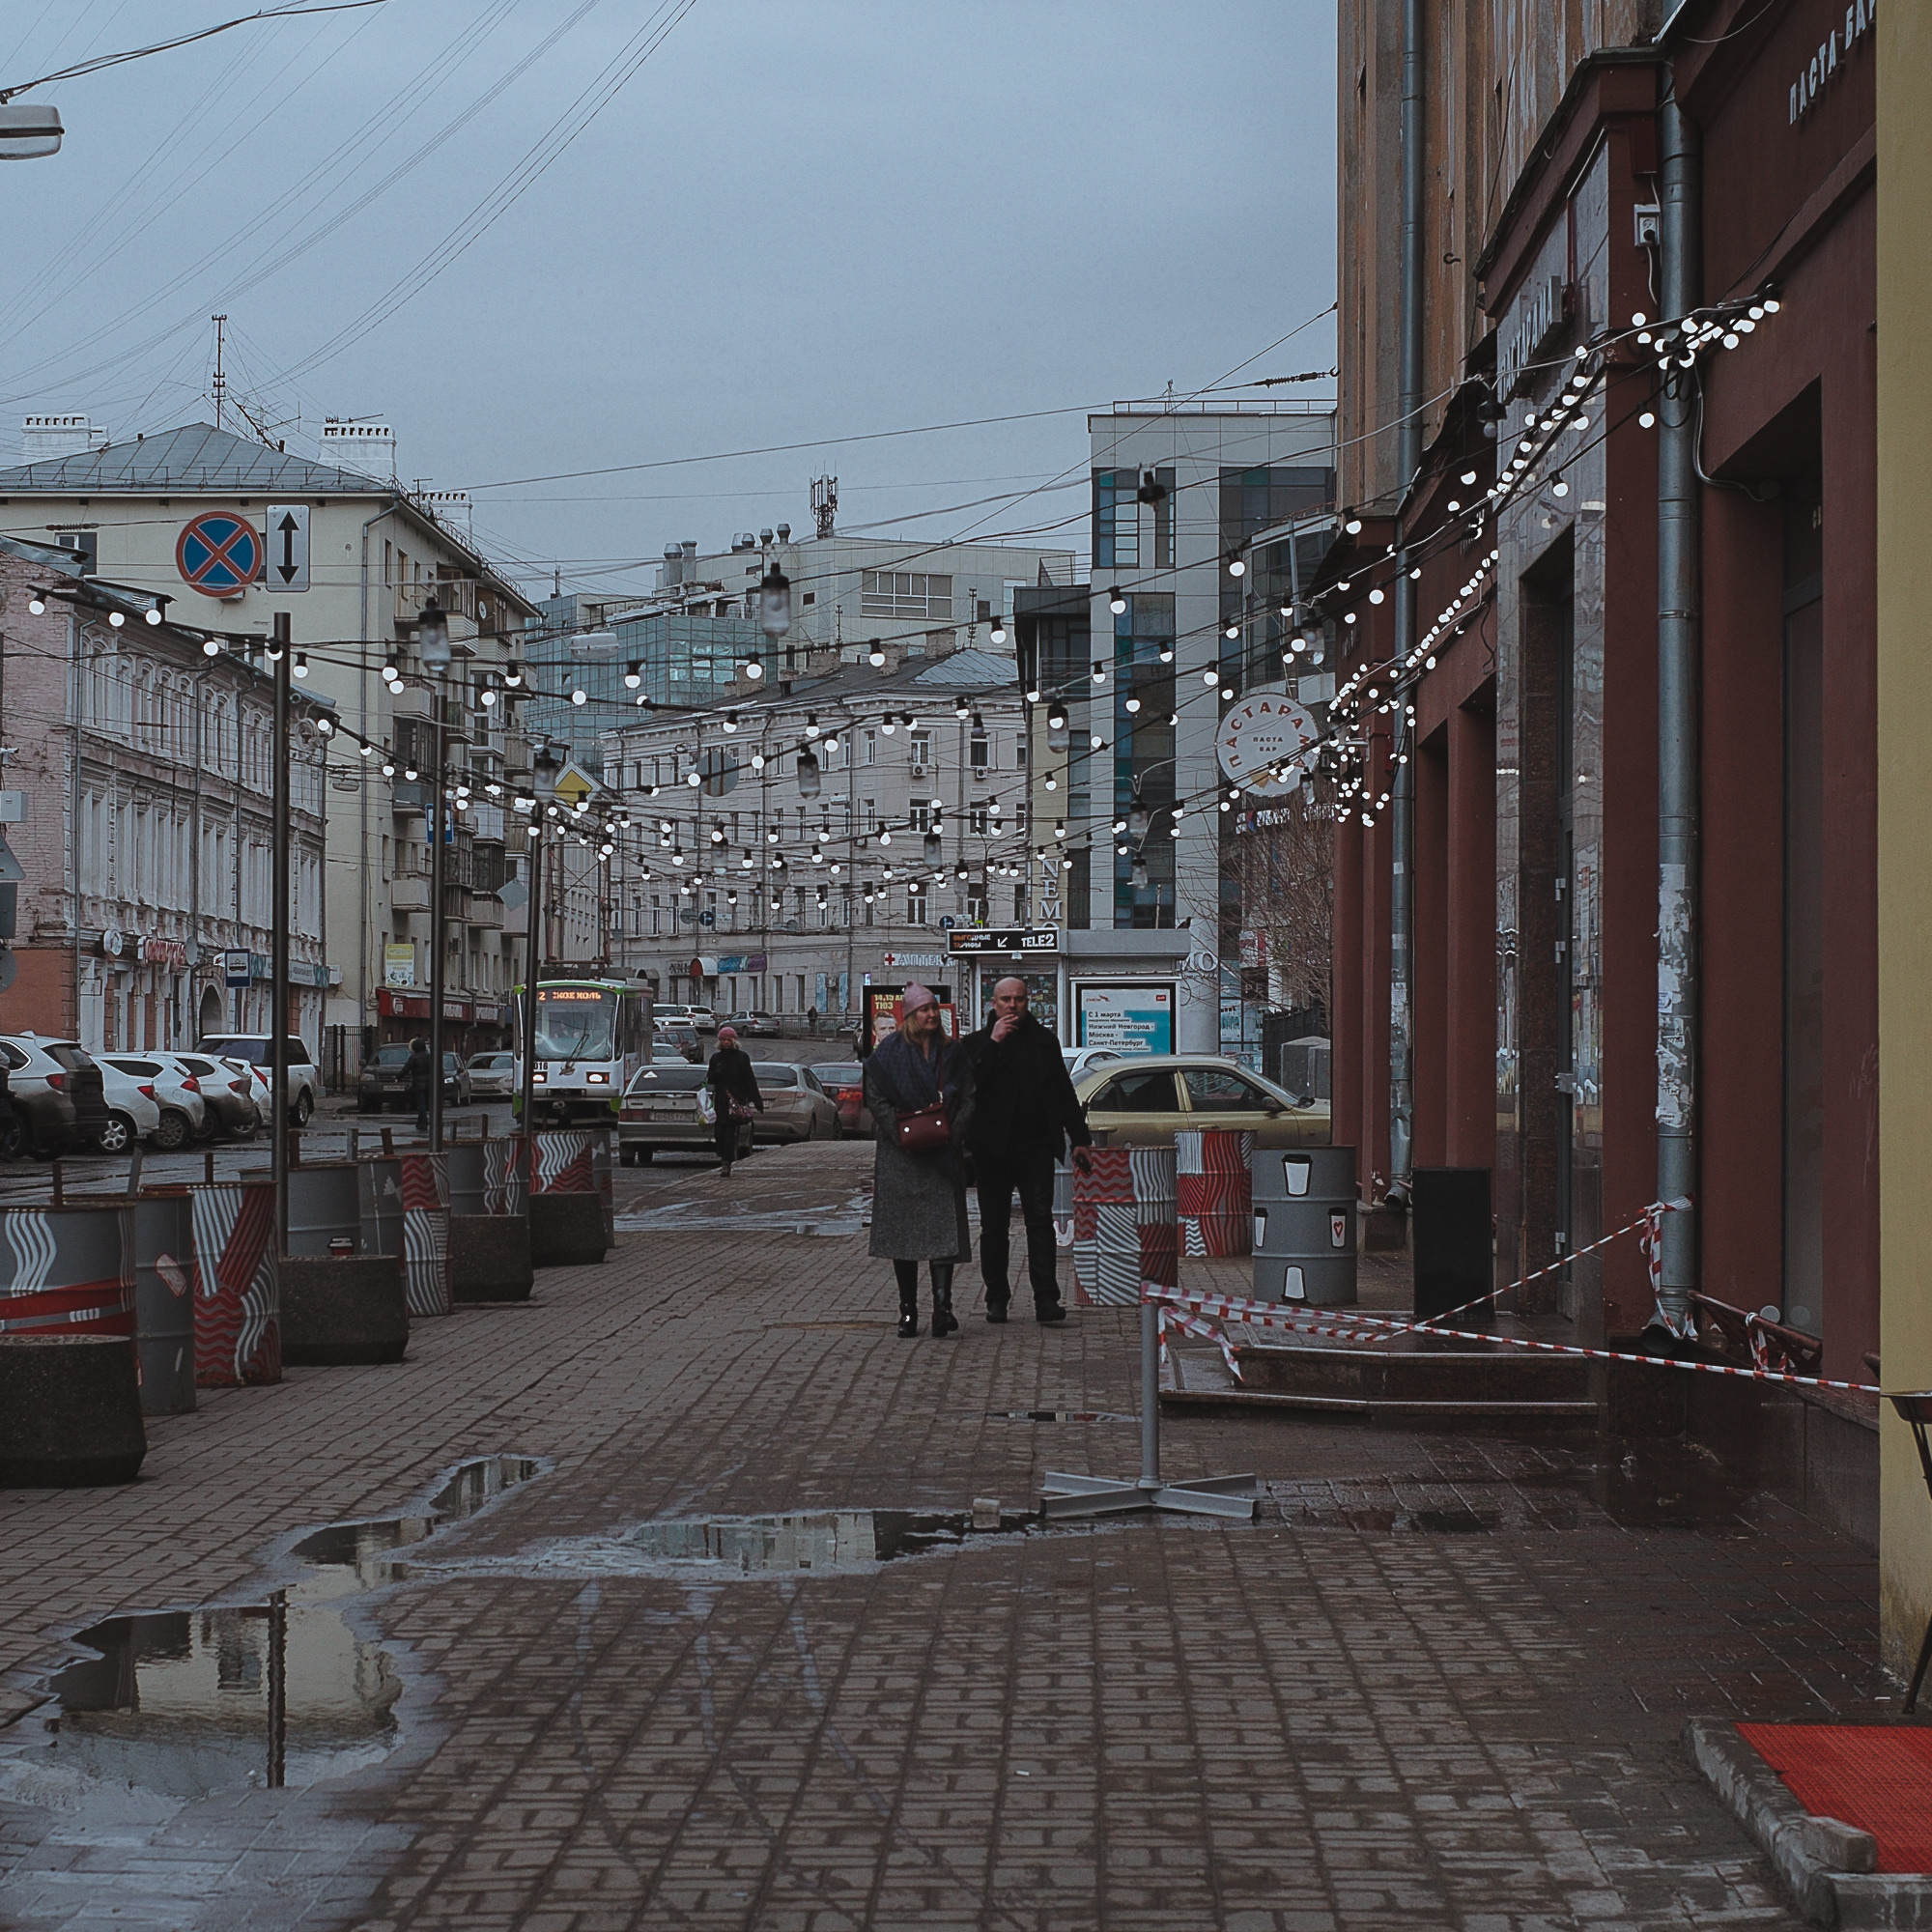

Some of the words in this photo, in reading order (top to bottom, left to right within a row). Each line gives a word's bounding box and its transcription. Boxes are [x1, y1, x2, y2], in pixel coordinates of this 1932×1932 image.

[1789, 29, 1837, 126] ПАСТА
[1021, 933, 1055, 948] TELE2
[538, 991, 546, 1001] 2
